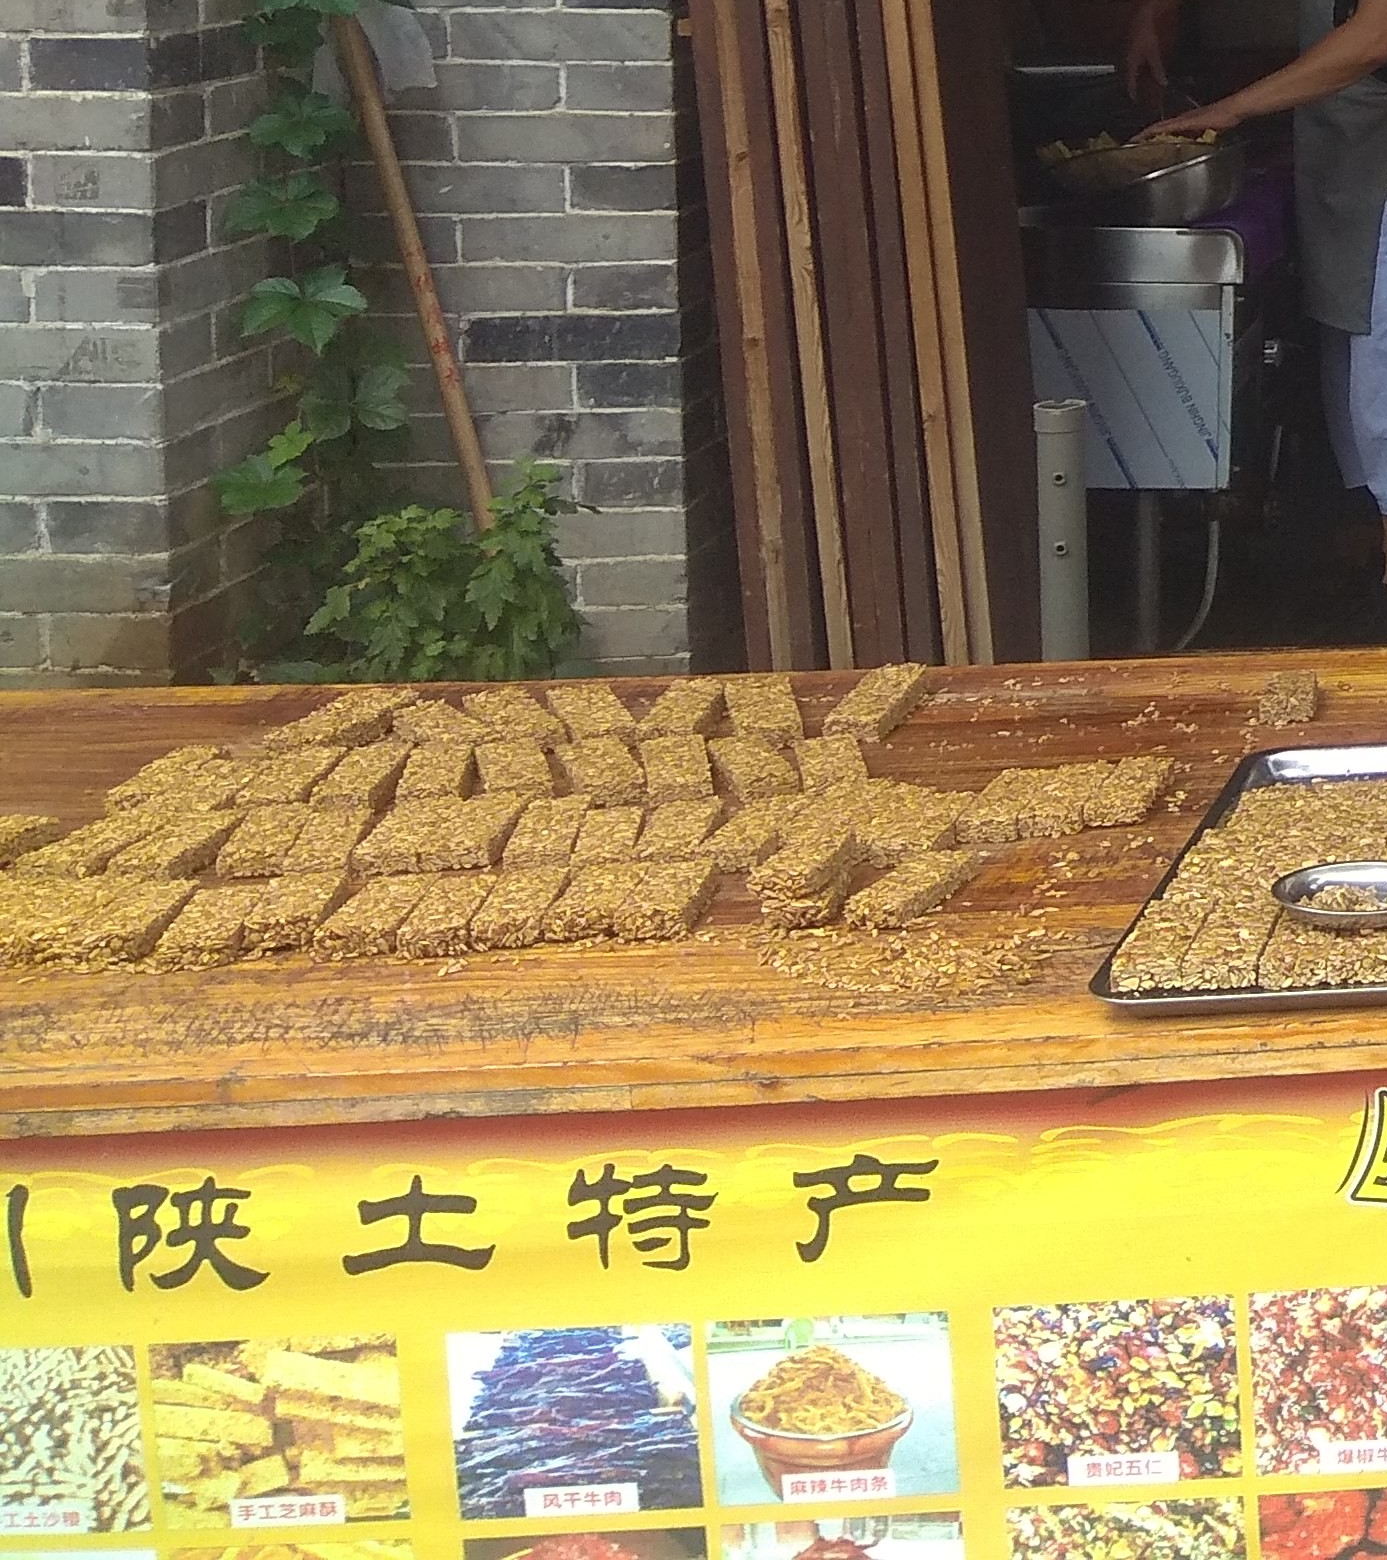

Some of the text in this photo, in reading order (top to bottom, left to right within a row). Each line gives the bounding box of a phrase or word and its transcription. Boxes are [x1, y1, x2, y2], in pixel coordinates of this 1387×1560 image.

[789, 1474, 890, 1496] 麻辣牛肉条
[542, 1489, 623, 1509] 风干牛肉
[237, 1500, 340, 1521] 手工芝麻酥
